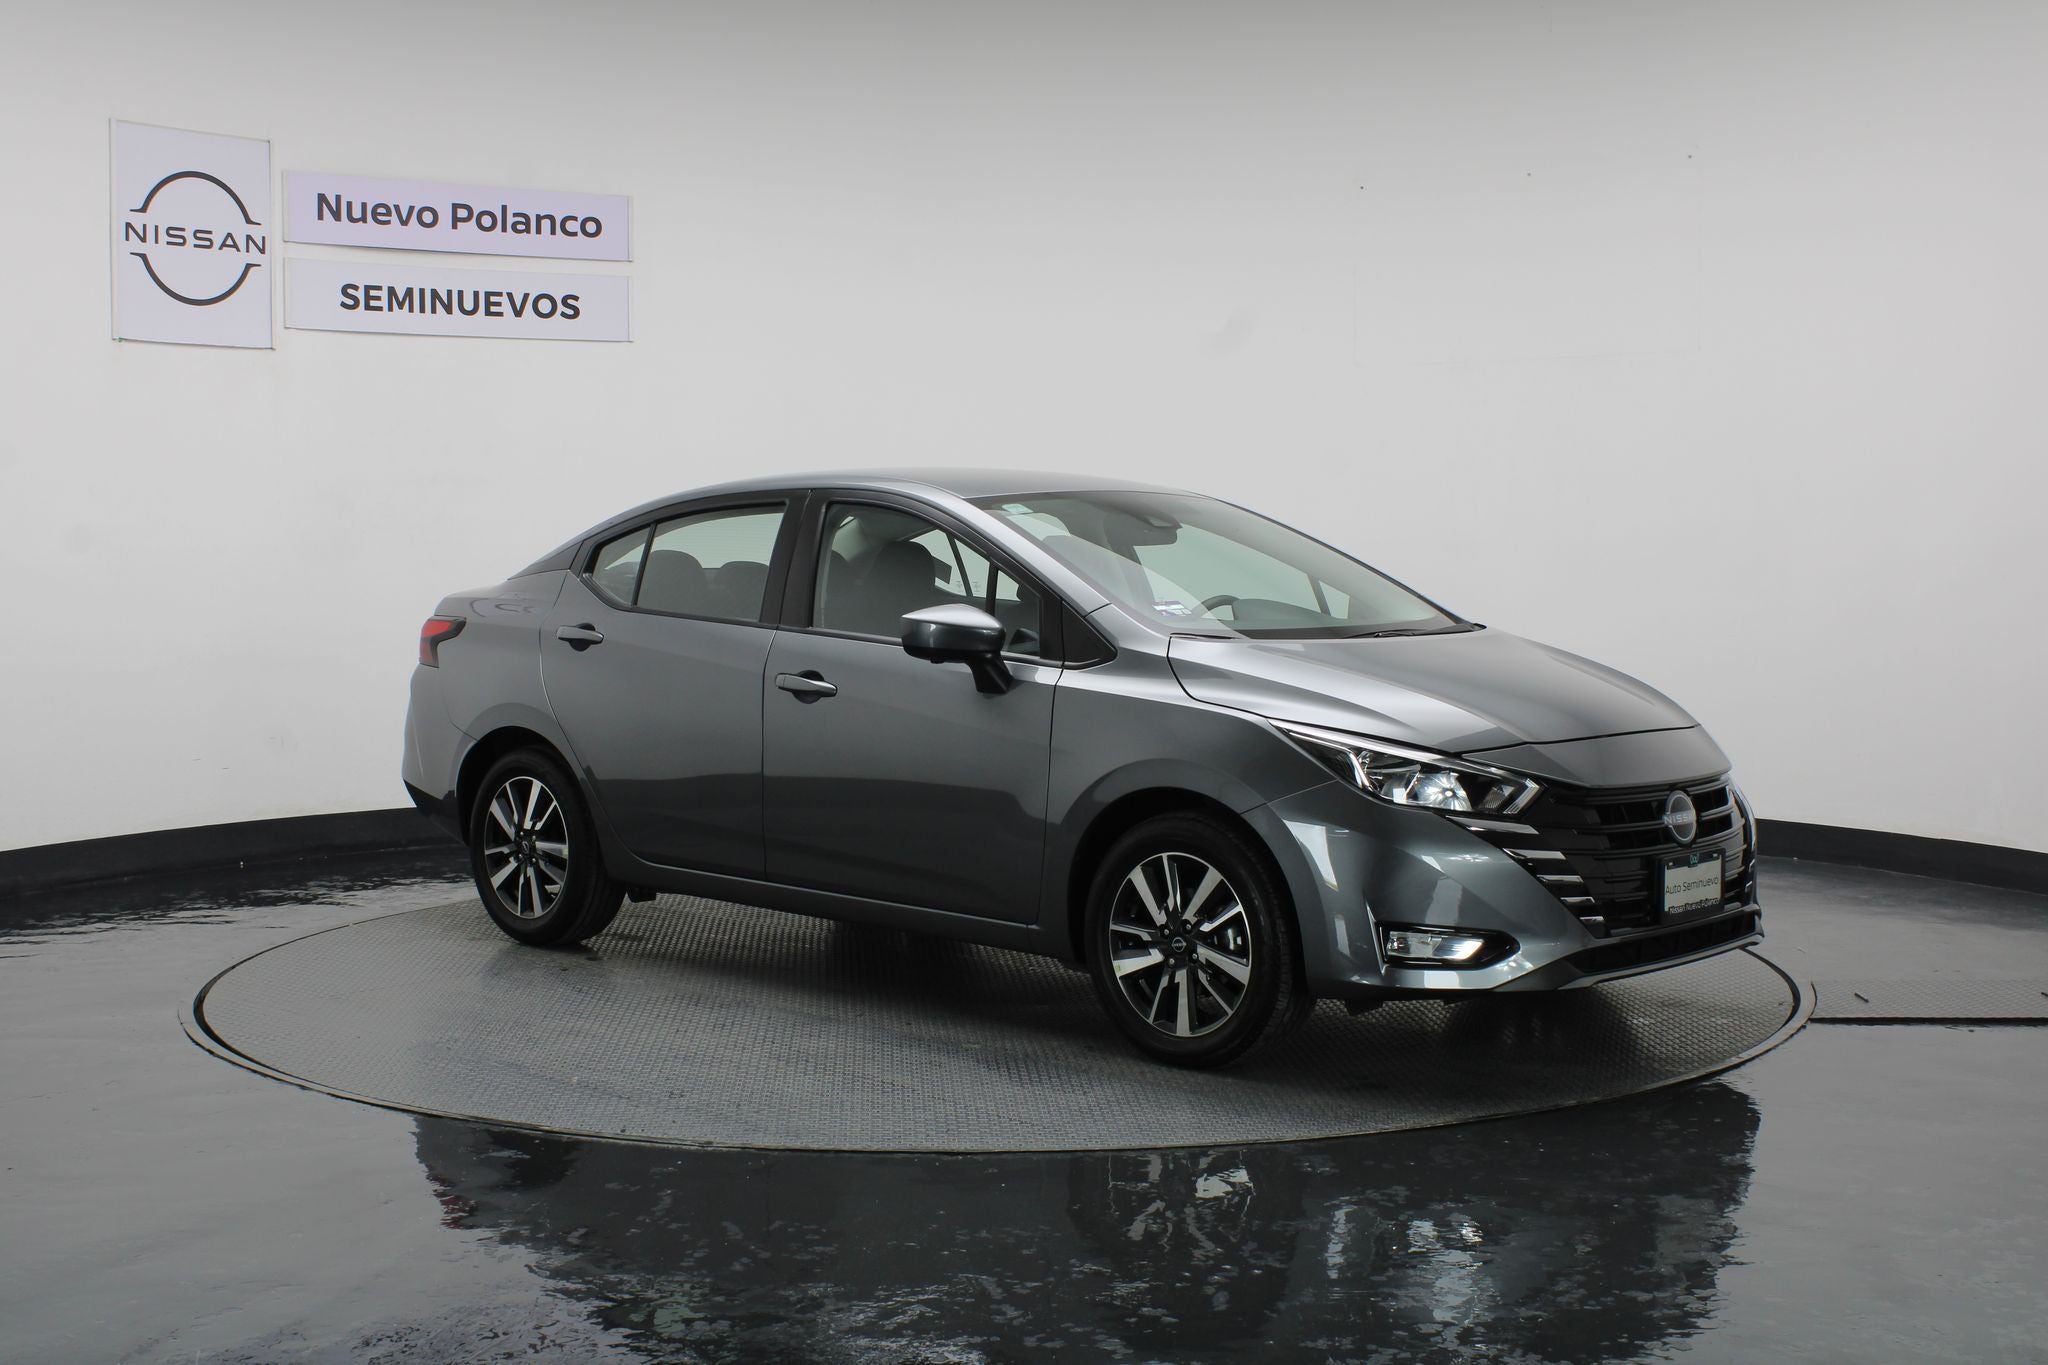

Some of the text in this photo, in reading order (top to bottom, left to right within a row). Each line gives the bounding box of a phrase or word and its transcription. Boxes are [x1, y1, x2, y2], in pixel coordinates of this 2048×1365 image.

[316, 192, 602, 238] Nuevo Polanco
[125, 221, 266, 255] NISSAN
[340, 283, 581, 320] SEMINUEVOS
[1665, 877, 1719, 894] Auto Seminuevo
